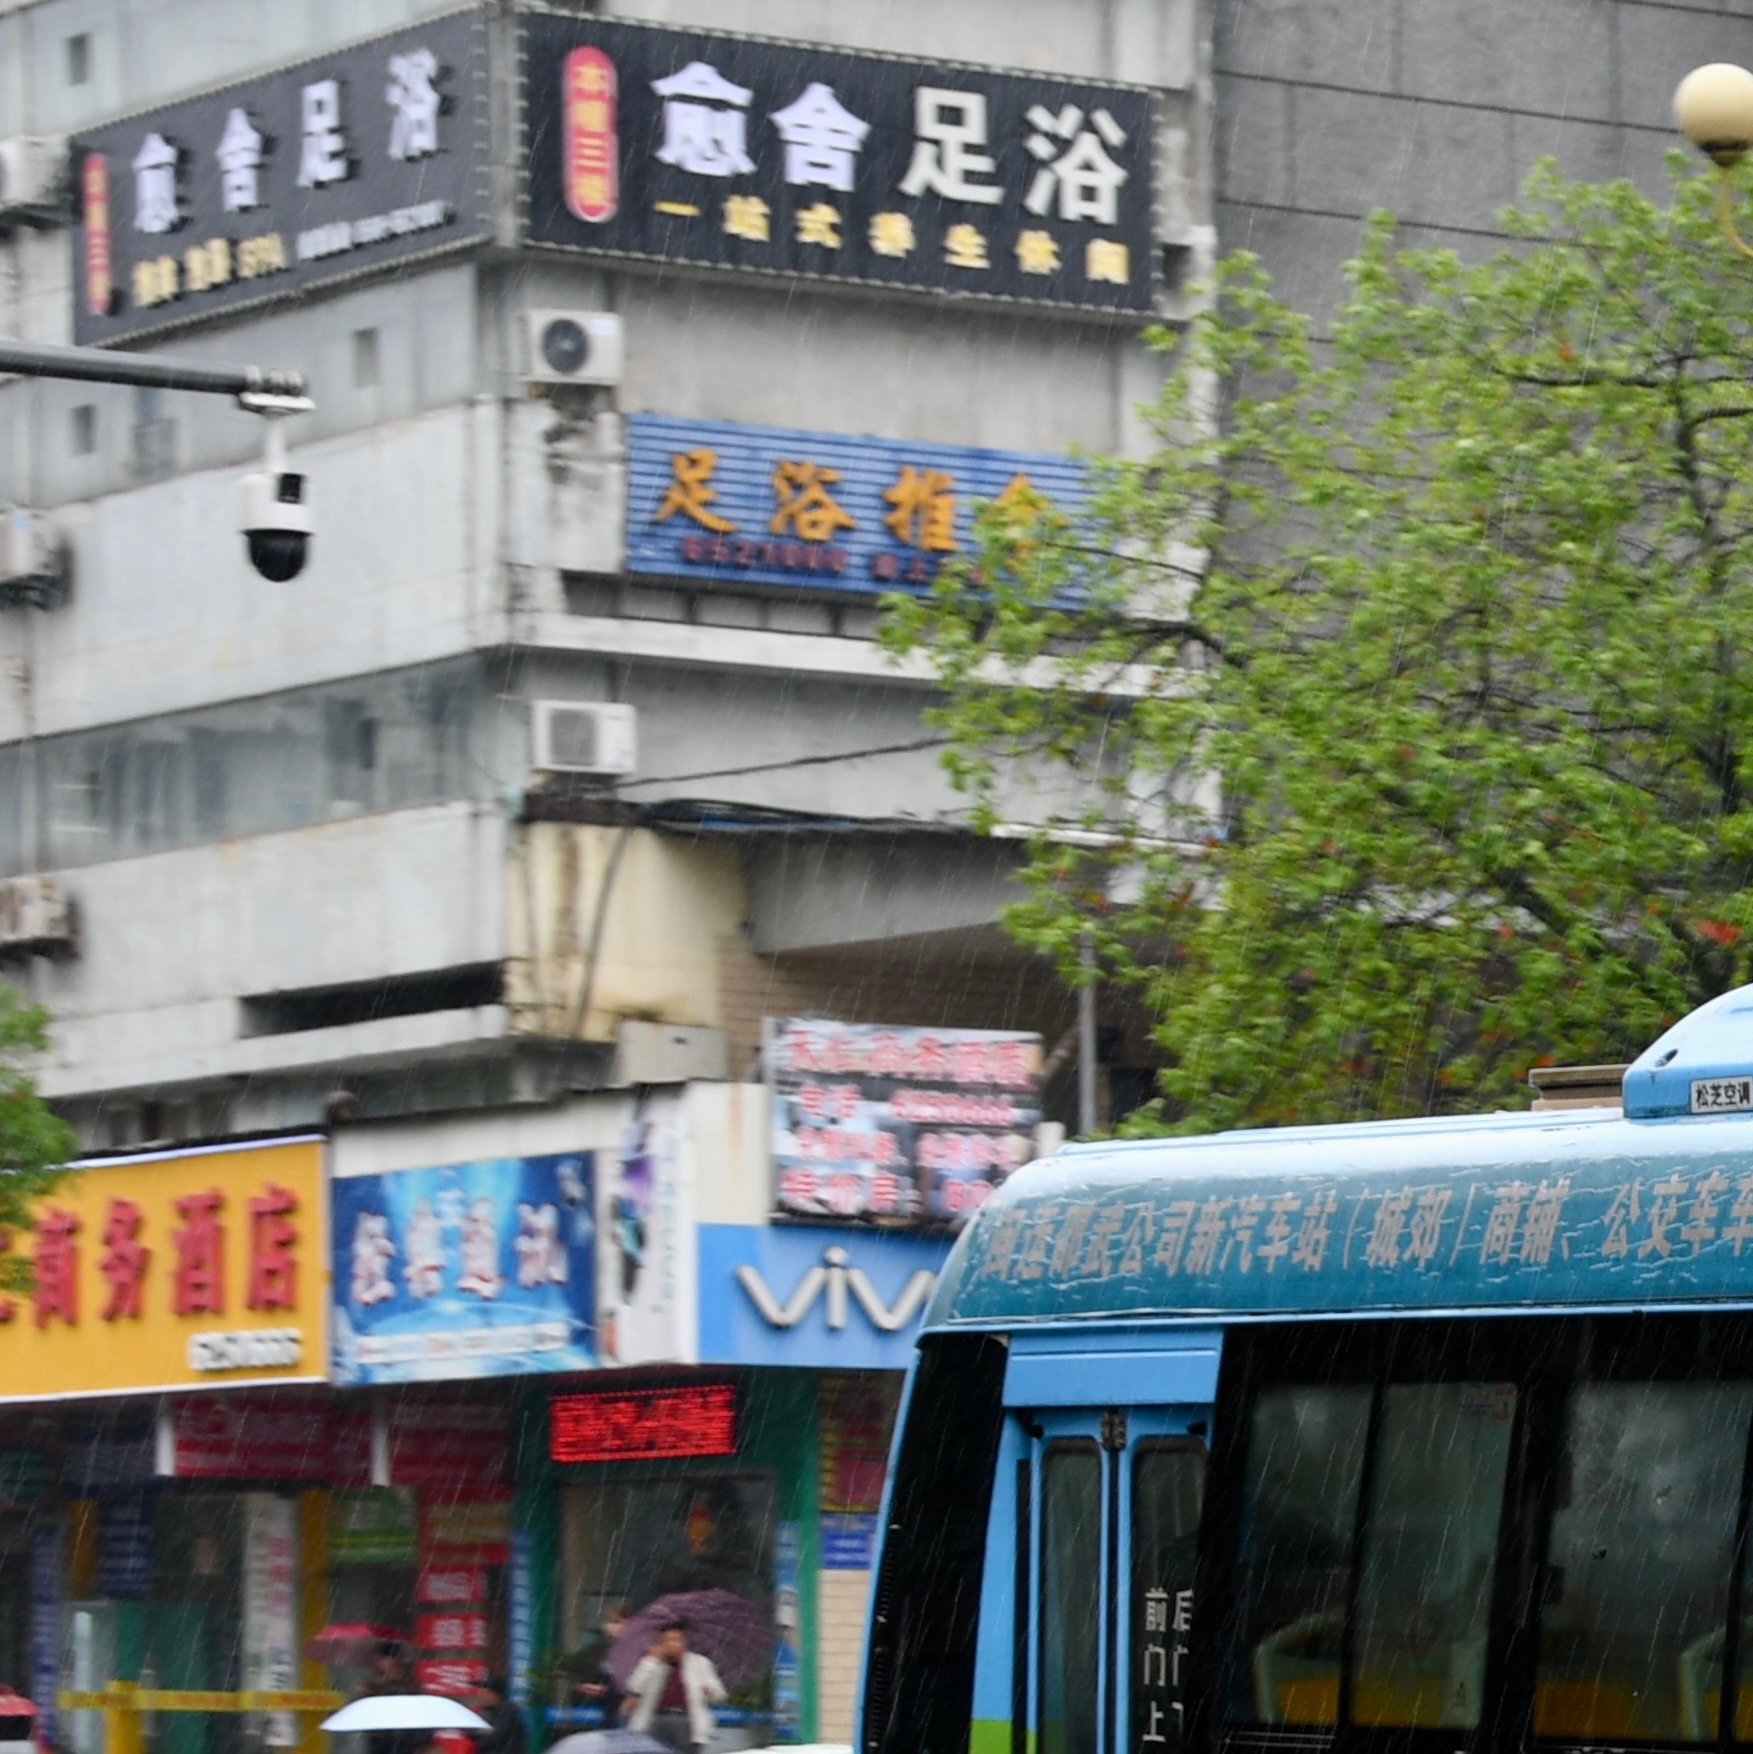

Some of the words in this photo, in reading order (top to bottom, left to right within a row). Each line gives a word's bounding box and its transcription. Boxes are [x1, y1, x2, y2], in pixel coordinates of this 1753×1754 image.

[1696, 1081, 1751, 1110] 松芝空调
[0, 1184, 298, 1327] 商务酒店
